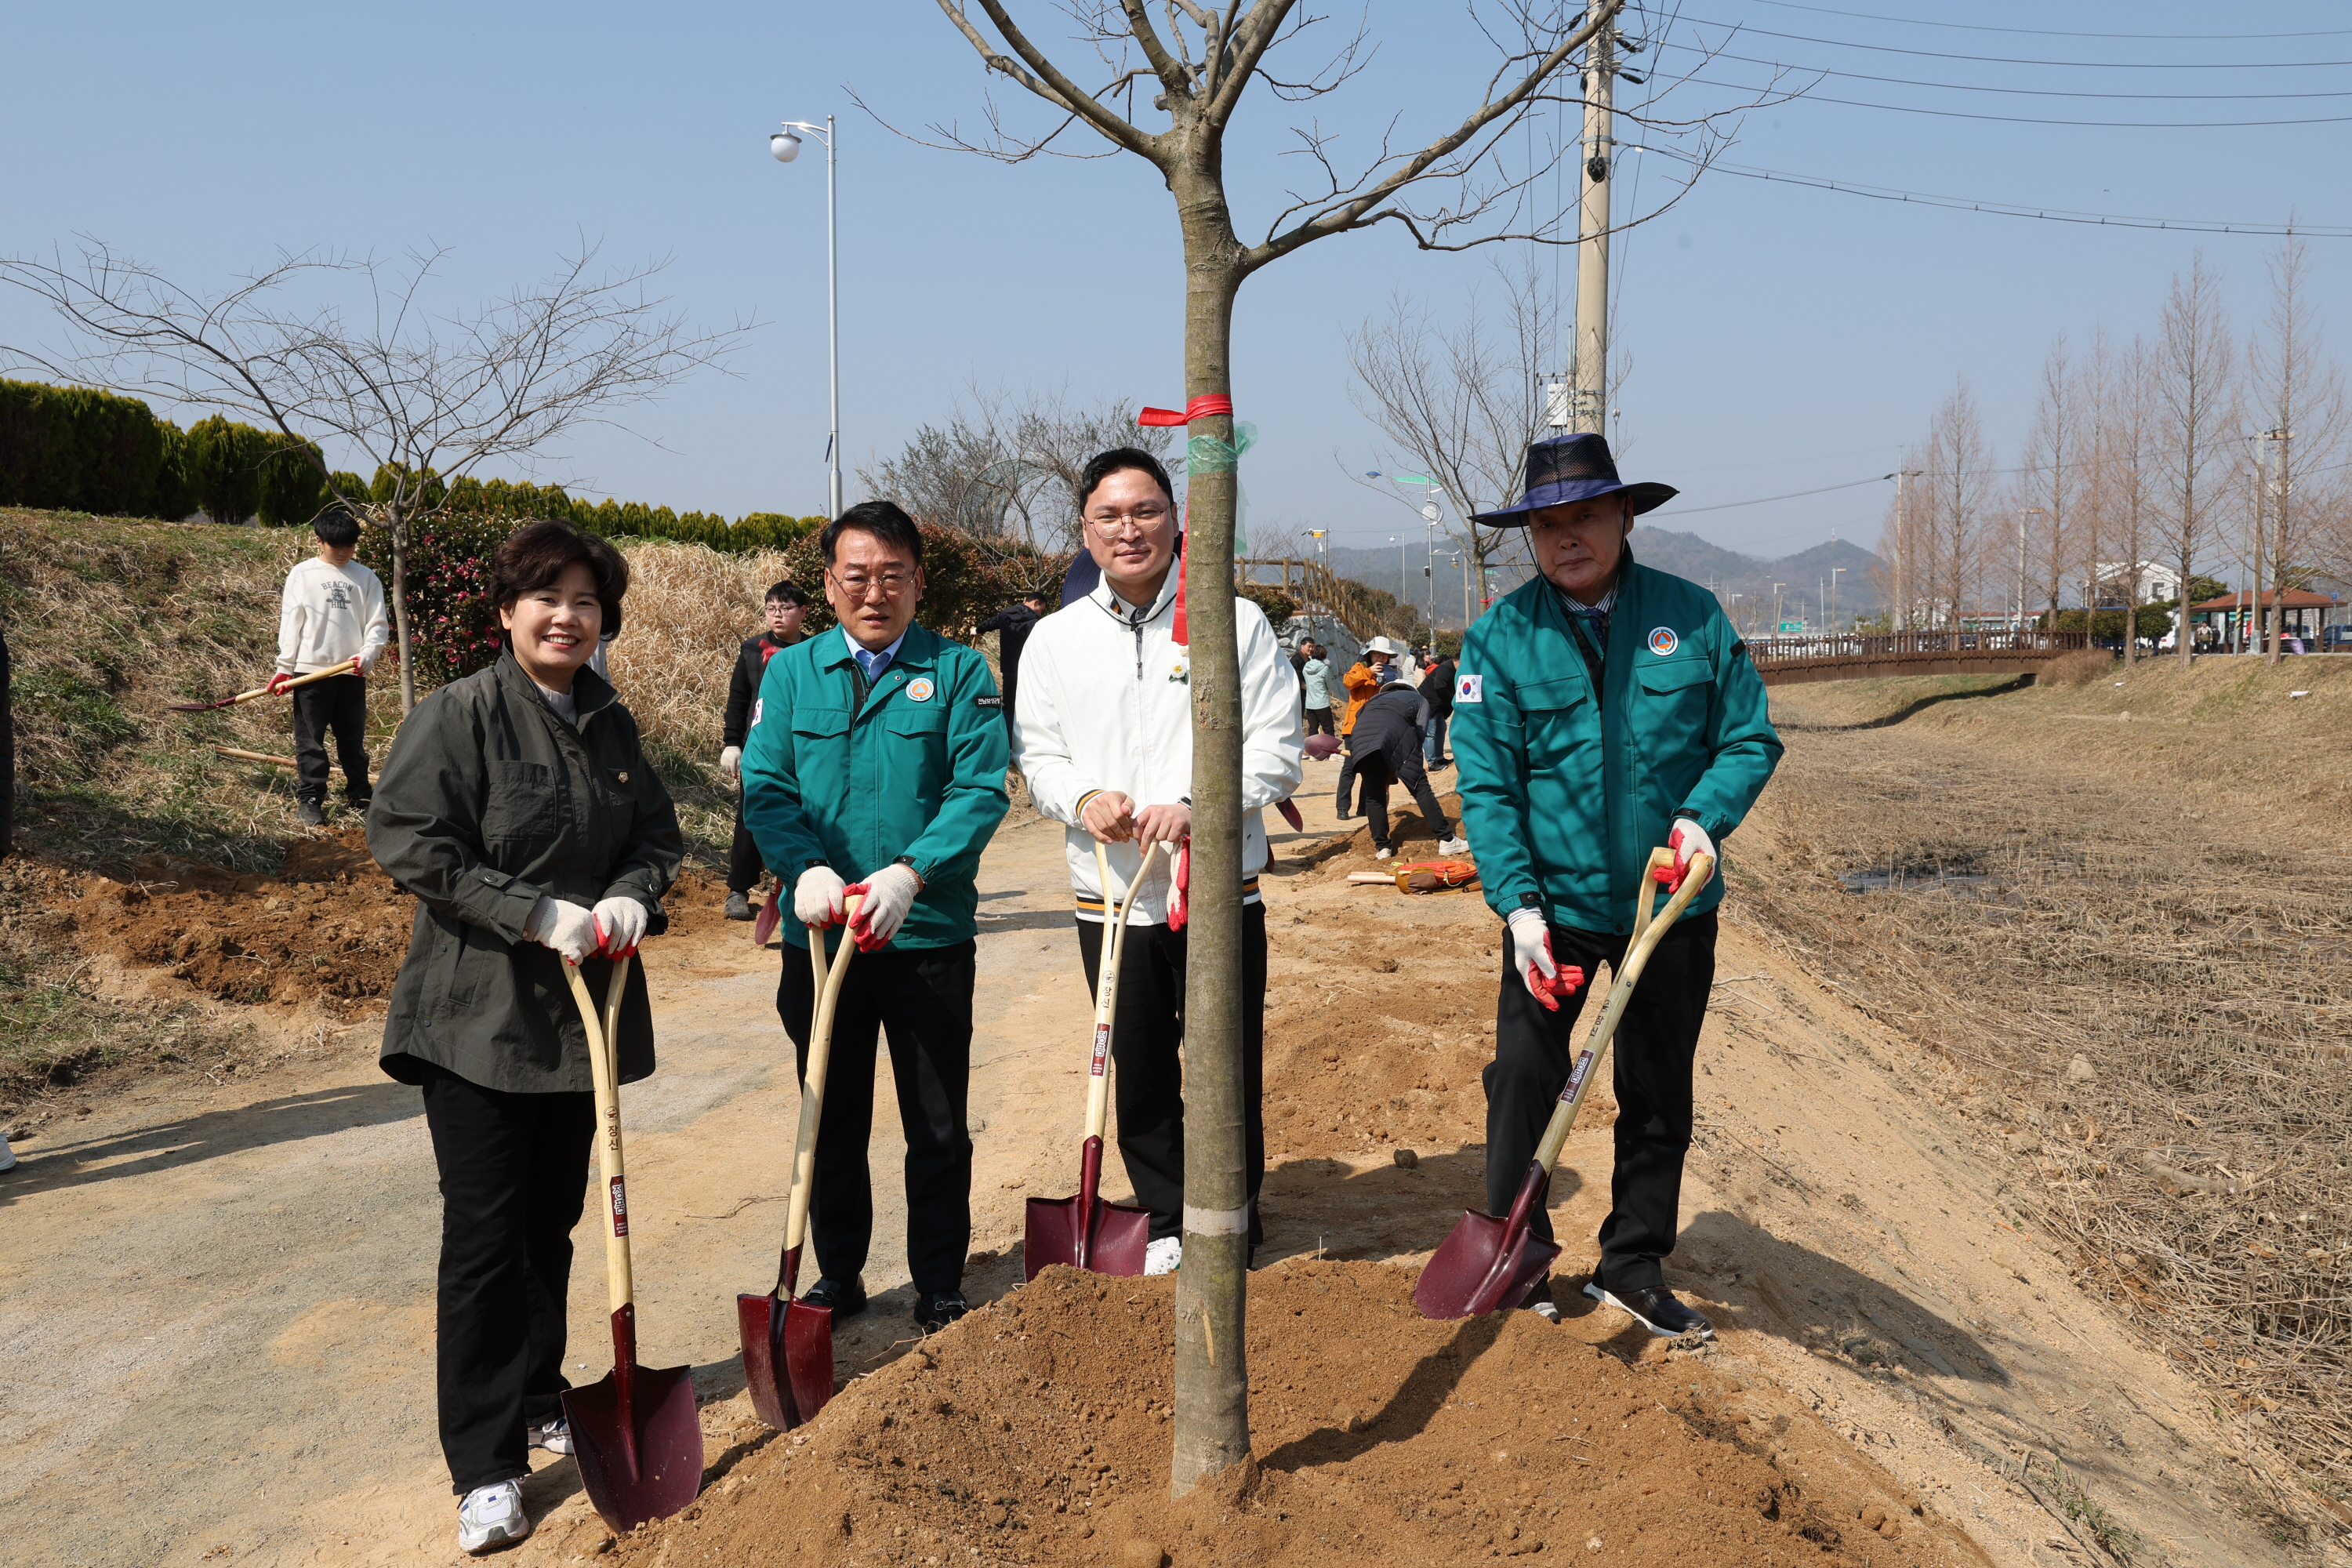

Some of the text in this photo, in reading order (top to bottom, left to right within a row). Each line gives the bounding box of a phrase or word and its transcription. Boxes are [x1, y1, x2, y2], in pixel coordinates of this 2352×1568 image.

[321, 581, 354, 592] BEACON
[332, 601, 347, 609] HILL
[1096, 1030, 1107, 1057] 정품
[1570, 1057, 1588, 1083] 정품
[608, 1124, 619, 1151] 장신
[612, 1183, 626, 1214] 정품
